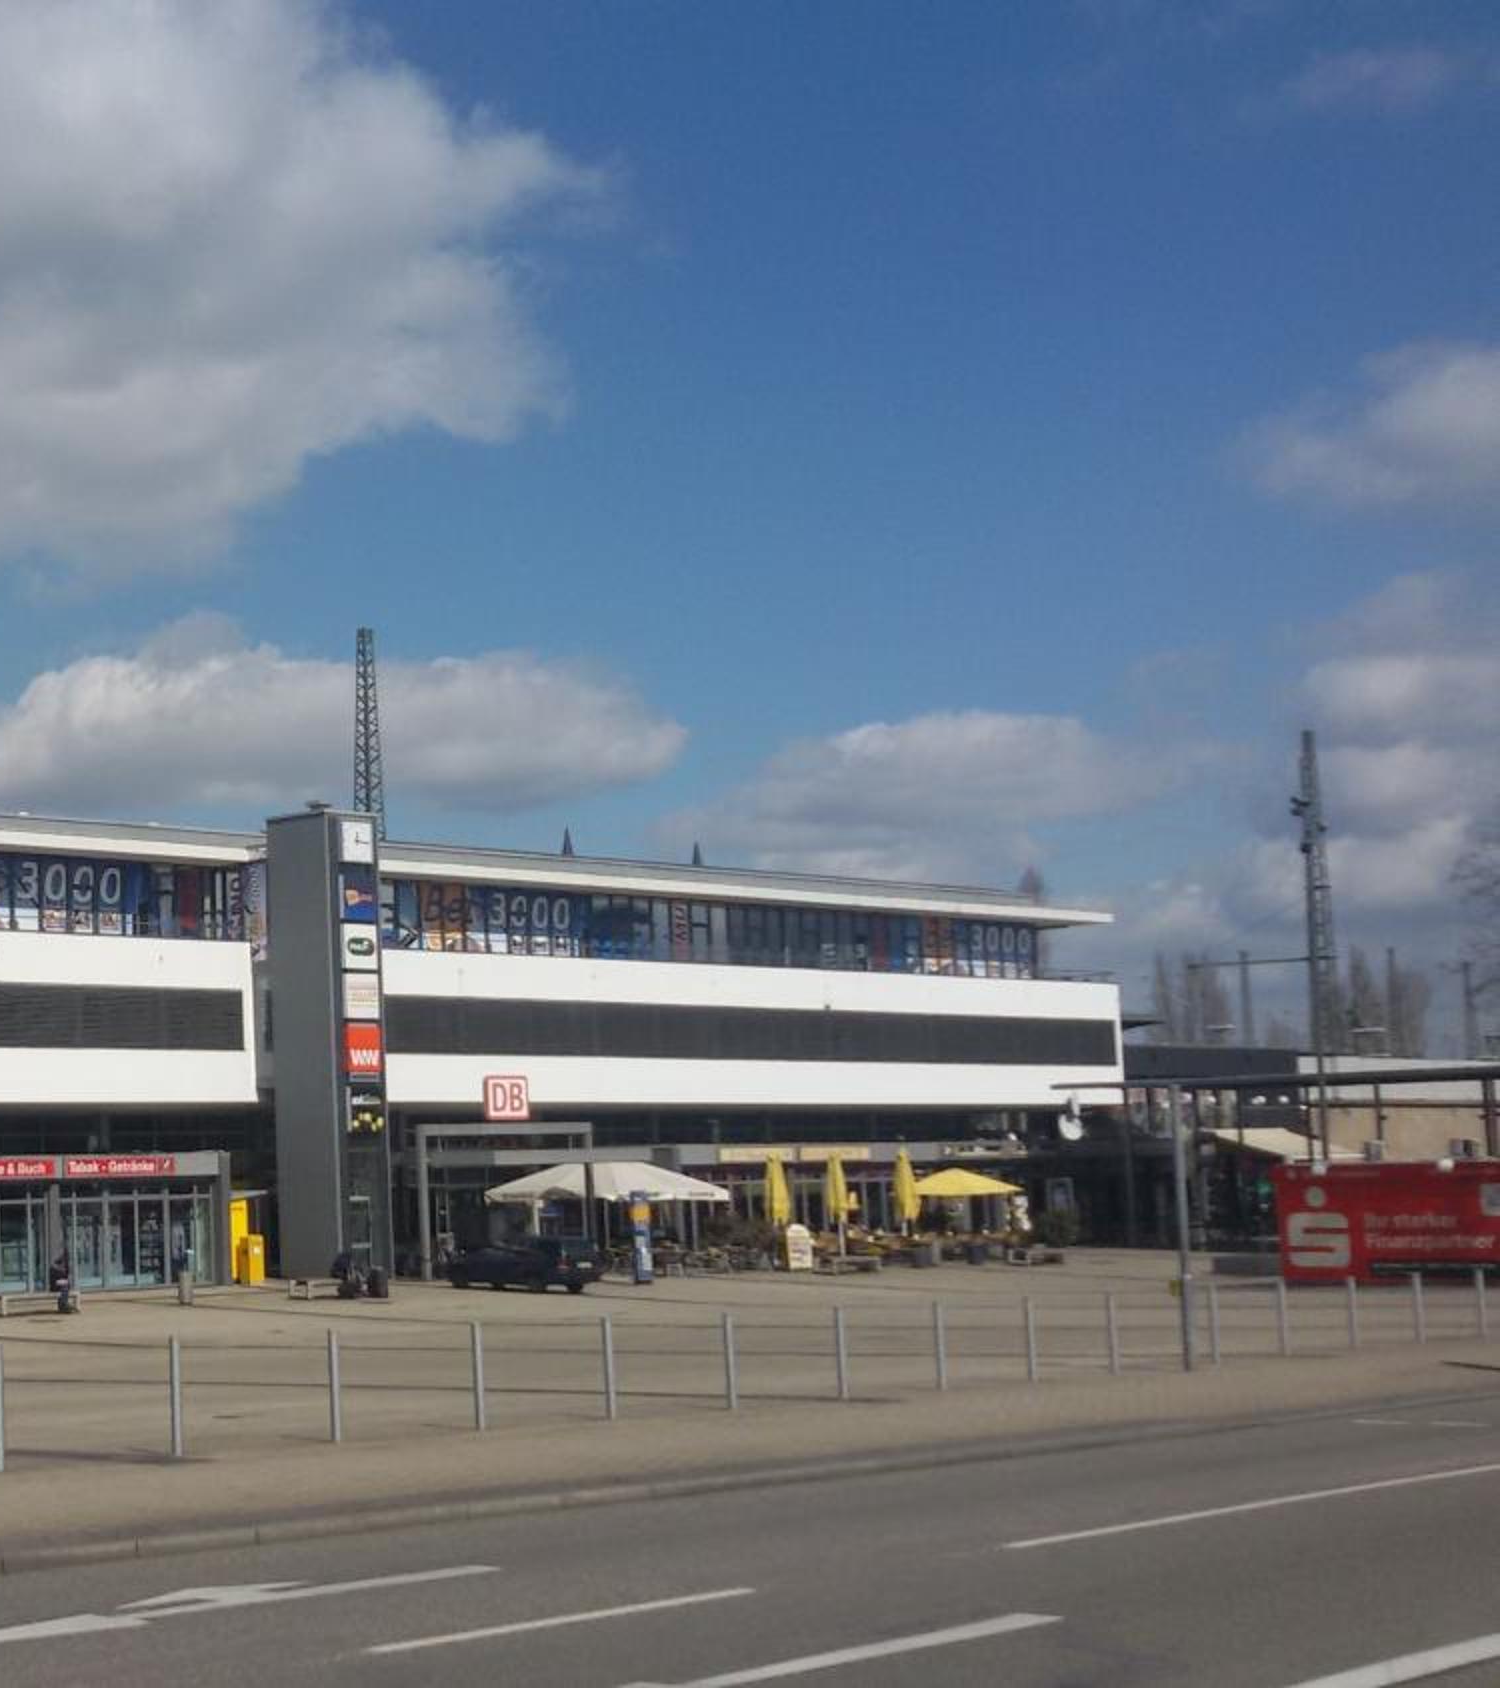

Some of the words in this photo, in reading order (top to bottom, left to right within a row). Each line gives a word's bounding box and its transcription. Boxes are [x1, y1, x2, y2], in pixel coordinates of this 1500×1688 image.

[17, 861, 122, 905] 3000
[489, 893, 570, 931] 3000
[491, 1082, 524, 1113] DB
[18, 1161, 46, 1175] Buch
